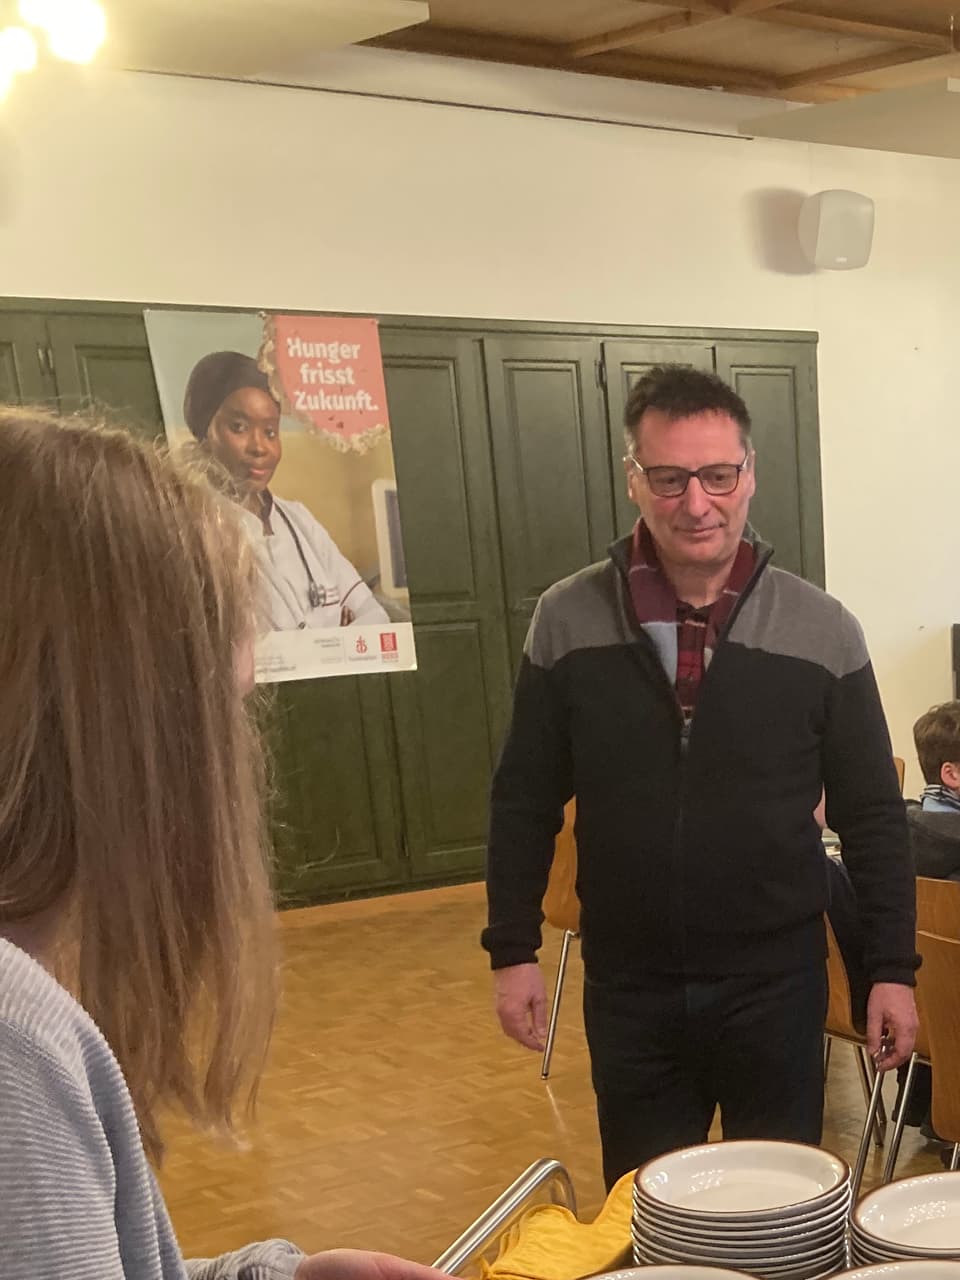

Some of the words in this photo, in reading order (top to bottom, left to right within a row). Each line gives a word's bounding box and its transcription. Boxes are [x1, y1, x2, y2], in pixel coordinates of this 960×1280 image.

[287, 336, 361, 364] Hunger
[300, 362, 356, 385] frisst
[293, 388, 379, 411] Zukunft.
